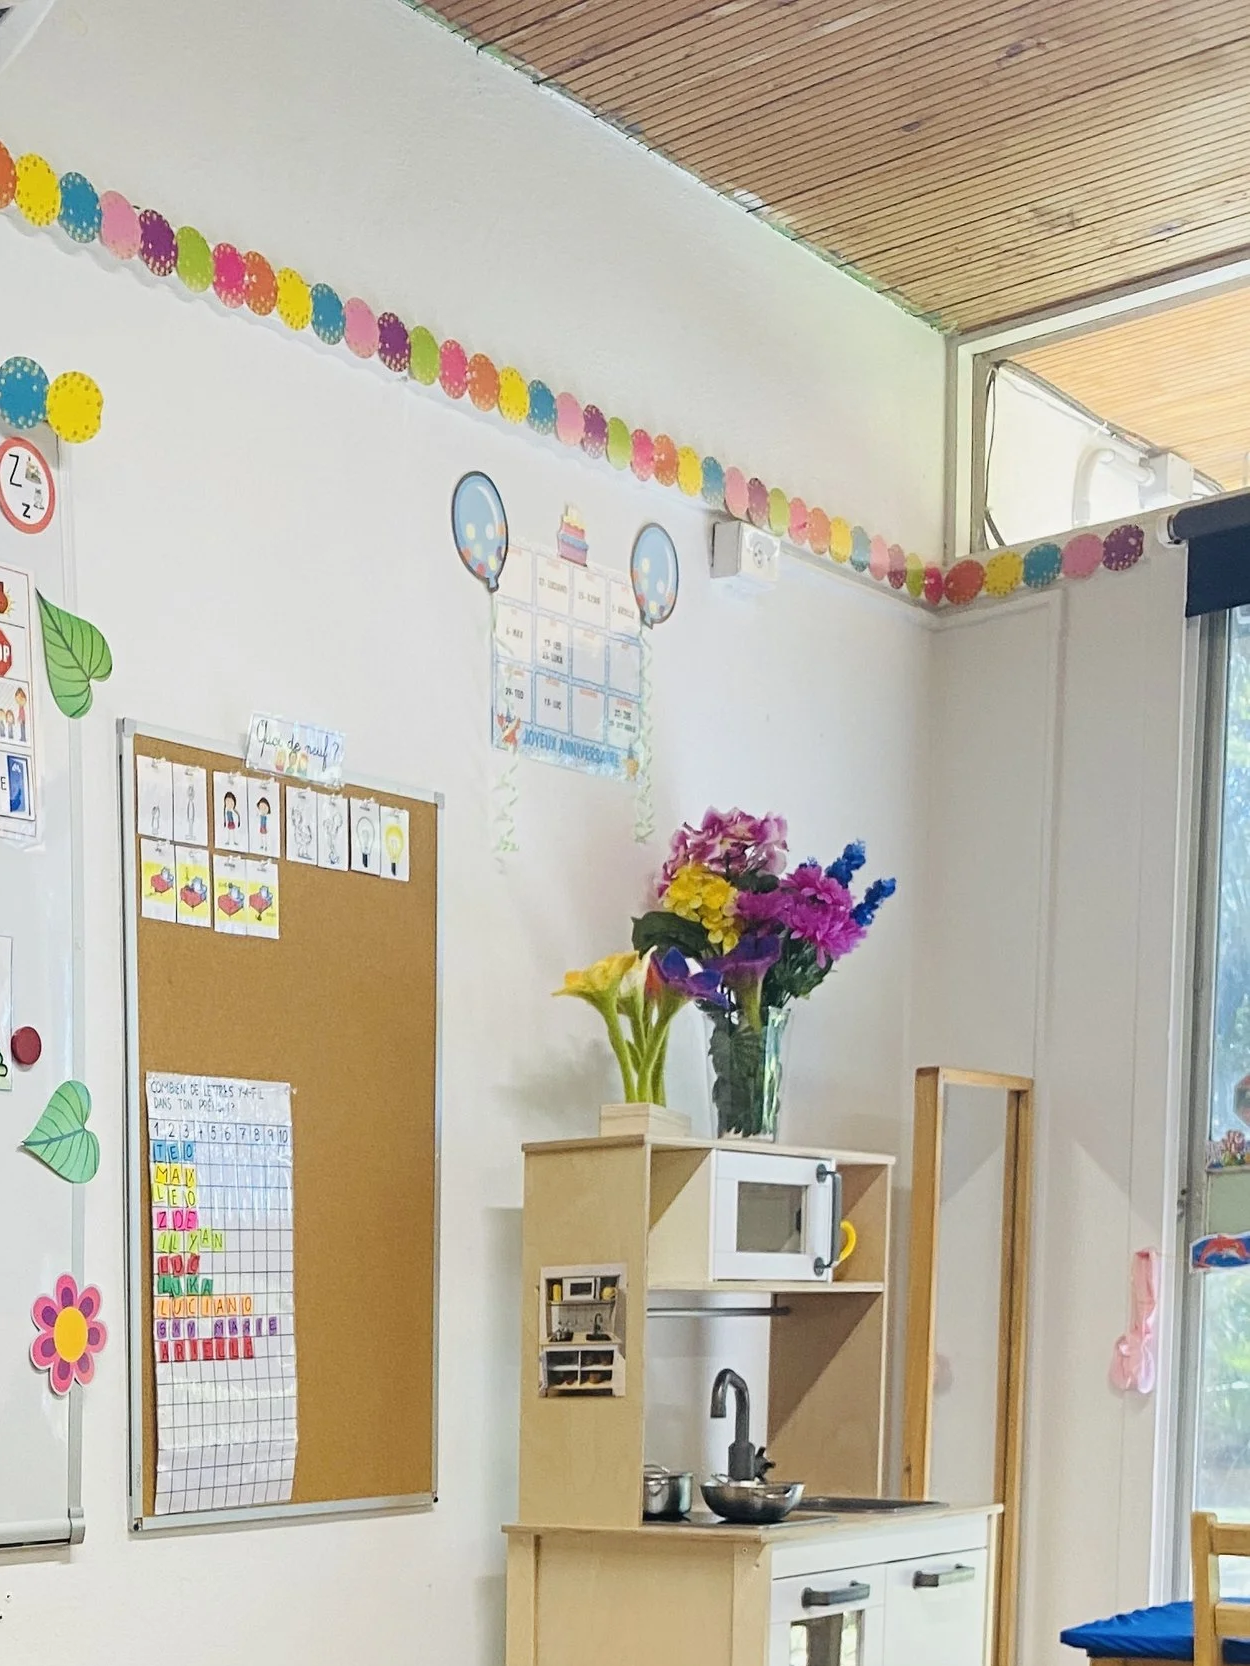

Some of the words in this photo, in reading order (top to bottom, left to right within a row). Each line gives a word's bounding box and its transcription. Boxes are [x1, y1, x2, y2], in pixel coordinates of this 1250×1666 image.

[8, 453, 22, 488] Z
[21, 502, 31, 519] z
[523, 728, 558, 751] JOYEUX
[287, 732, 301, 752] de
[305, 734, 329, 772] neuf
[154, 1121, 159, 1137] 1
[168, 1122, 175, 1138] 2
[183, 1123, 190, 1138] 3
[210, 1125, 217, 1141] 5
[224, 1126, 231, 1141] 6
[239, 1127, 246, 1140] 7
[254, 1127, 260, 1142] 8
[267, 1129, 273, 1142] 9
[278, 1130, 288, 1143] 10
[156, 1144, 194, 1161] TEO
[156, 1166, 195, 1185] MAX
[157, 1184, 196, 1207] LEO
[161, 1276, 212, 1296] LUKA
[161, 1296, 252, 1316] LUCIANO
